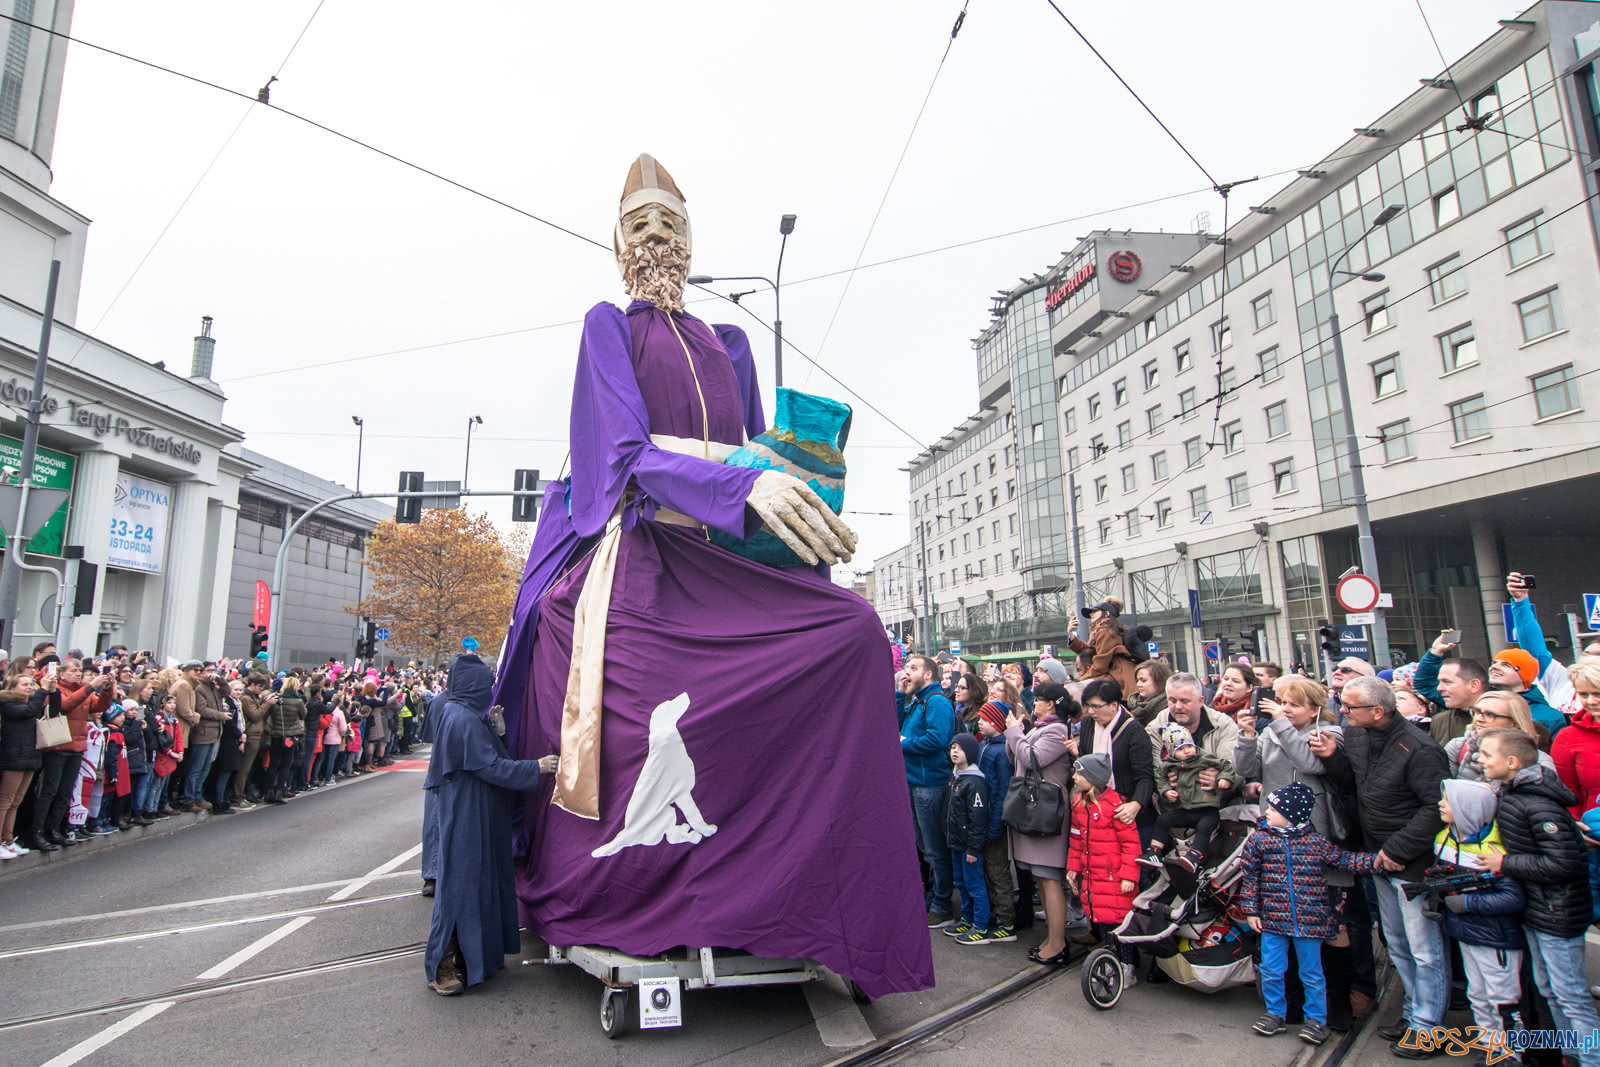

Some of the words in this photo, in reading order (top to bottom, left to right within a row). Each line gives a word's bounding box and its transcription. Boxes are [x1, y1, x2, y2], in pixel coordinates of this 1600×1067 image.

[1045, 262, 1095, 312] Sheraton
[114, 416, 202, 465] Poznańskie
[129, 486, 169, 506] OPTYKA
[109, 537, 152, 554] ISTOPADA
[973, 792, 984, 808] A
